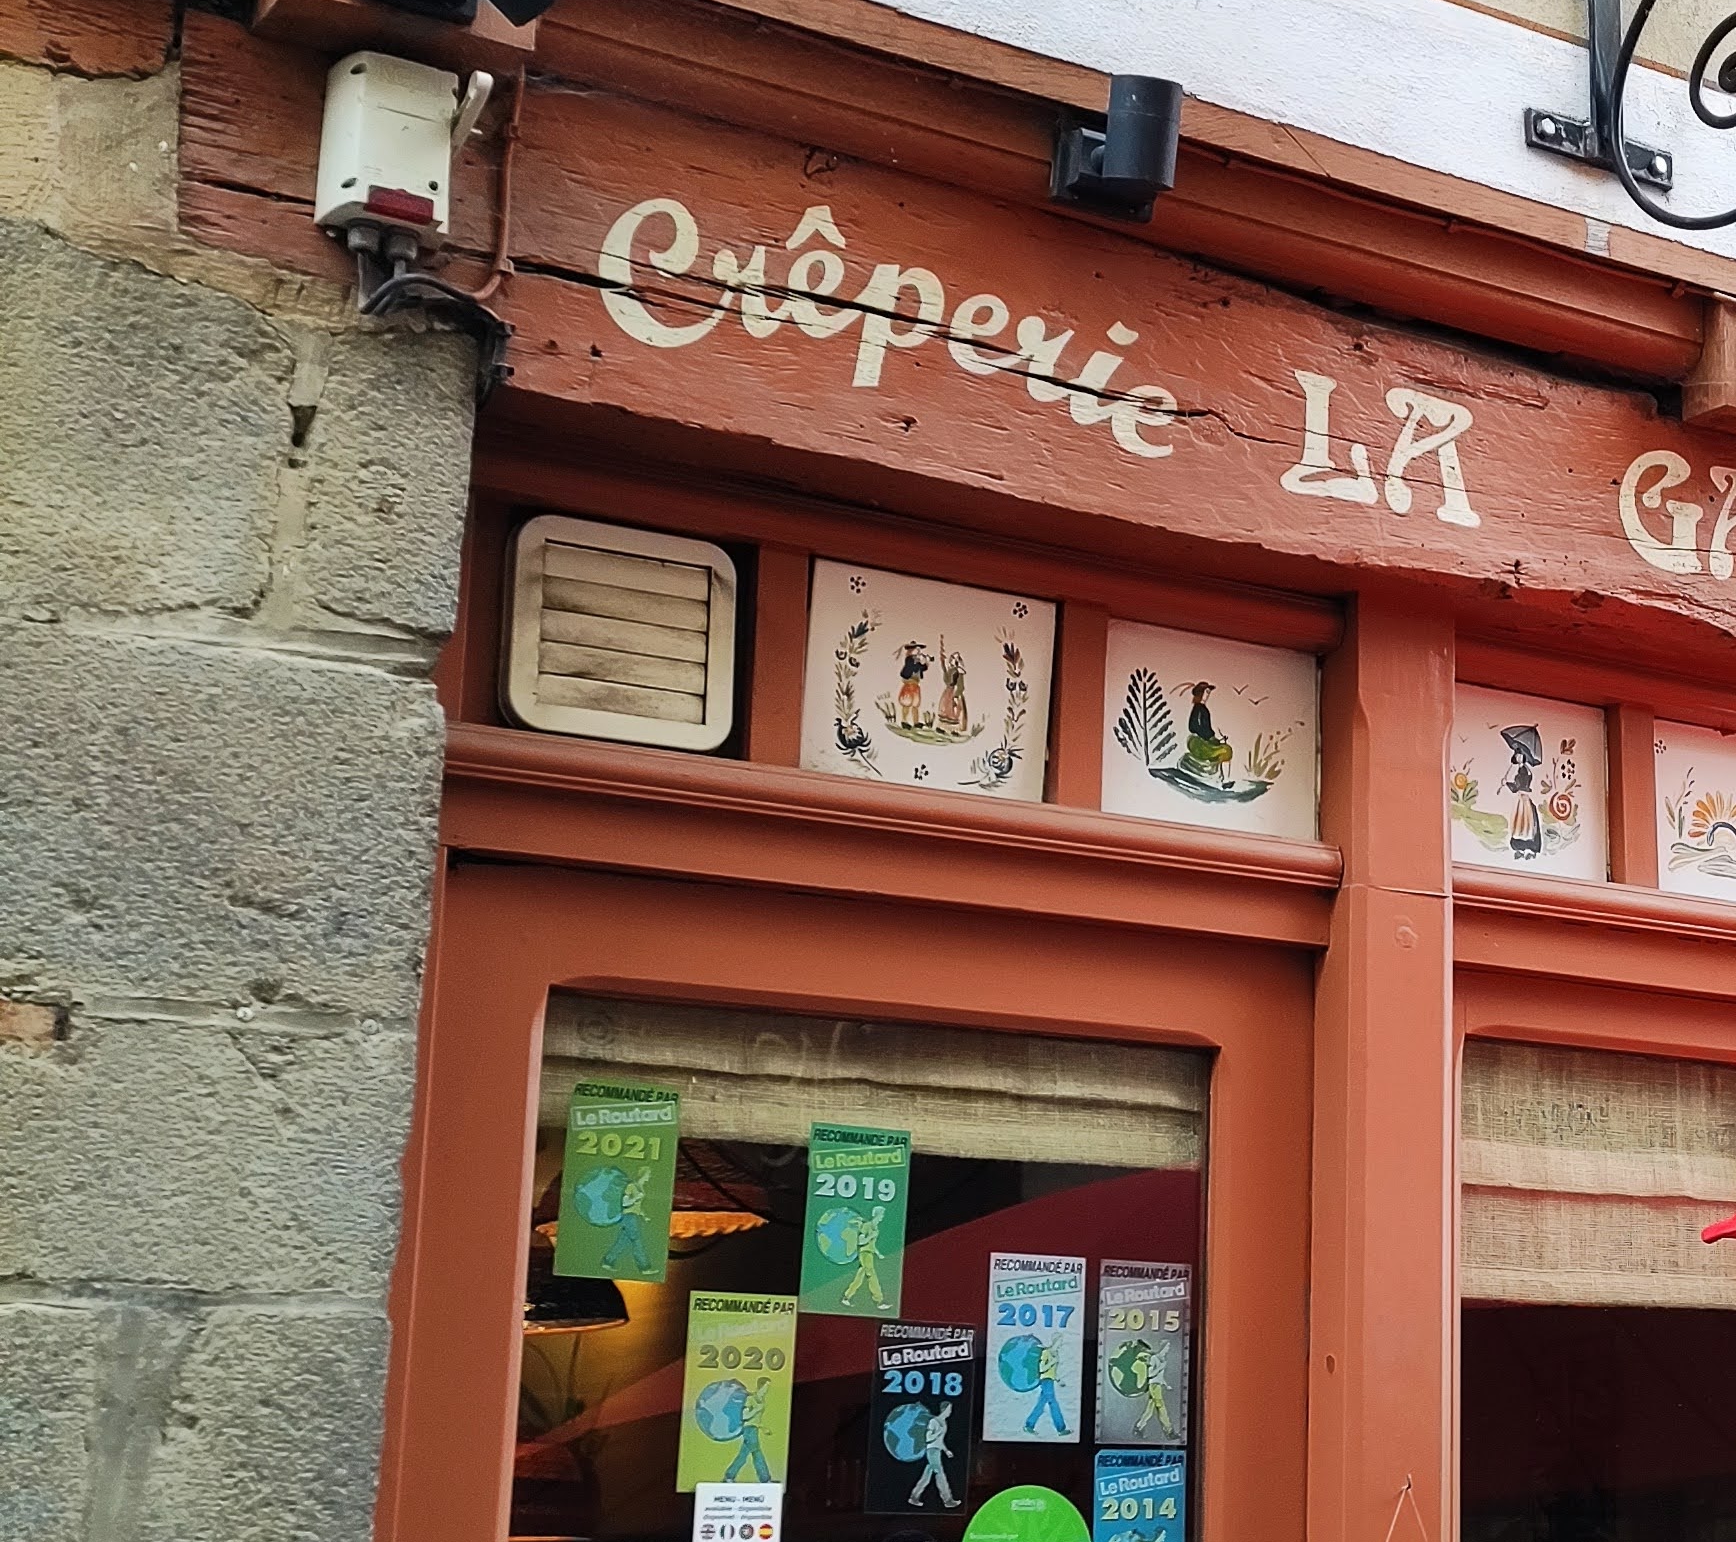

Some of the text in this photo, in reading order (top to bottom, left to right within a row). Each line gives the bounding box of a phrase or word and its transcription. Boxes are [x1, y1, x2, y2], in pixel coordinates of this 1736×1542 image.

[598, 198, 1177, 457] Crêperie
[1280, 368, 1481, 528] LA
[576, 1131, 661, 1160] 2021
[814, 1173, 896, 1201] 2019
[998, 1304, 1074, 1328] 2017
[1109, 1308, 1179, 1332] 2015
[698, 1344, 785, 1371] 2020
[882, 1370, 963, 1396] 2018
[1101, 1497, 1177, 1521] 2014
